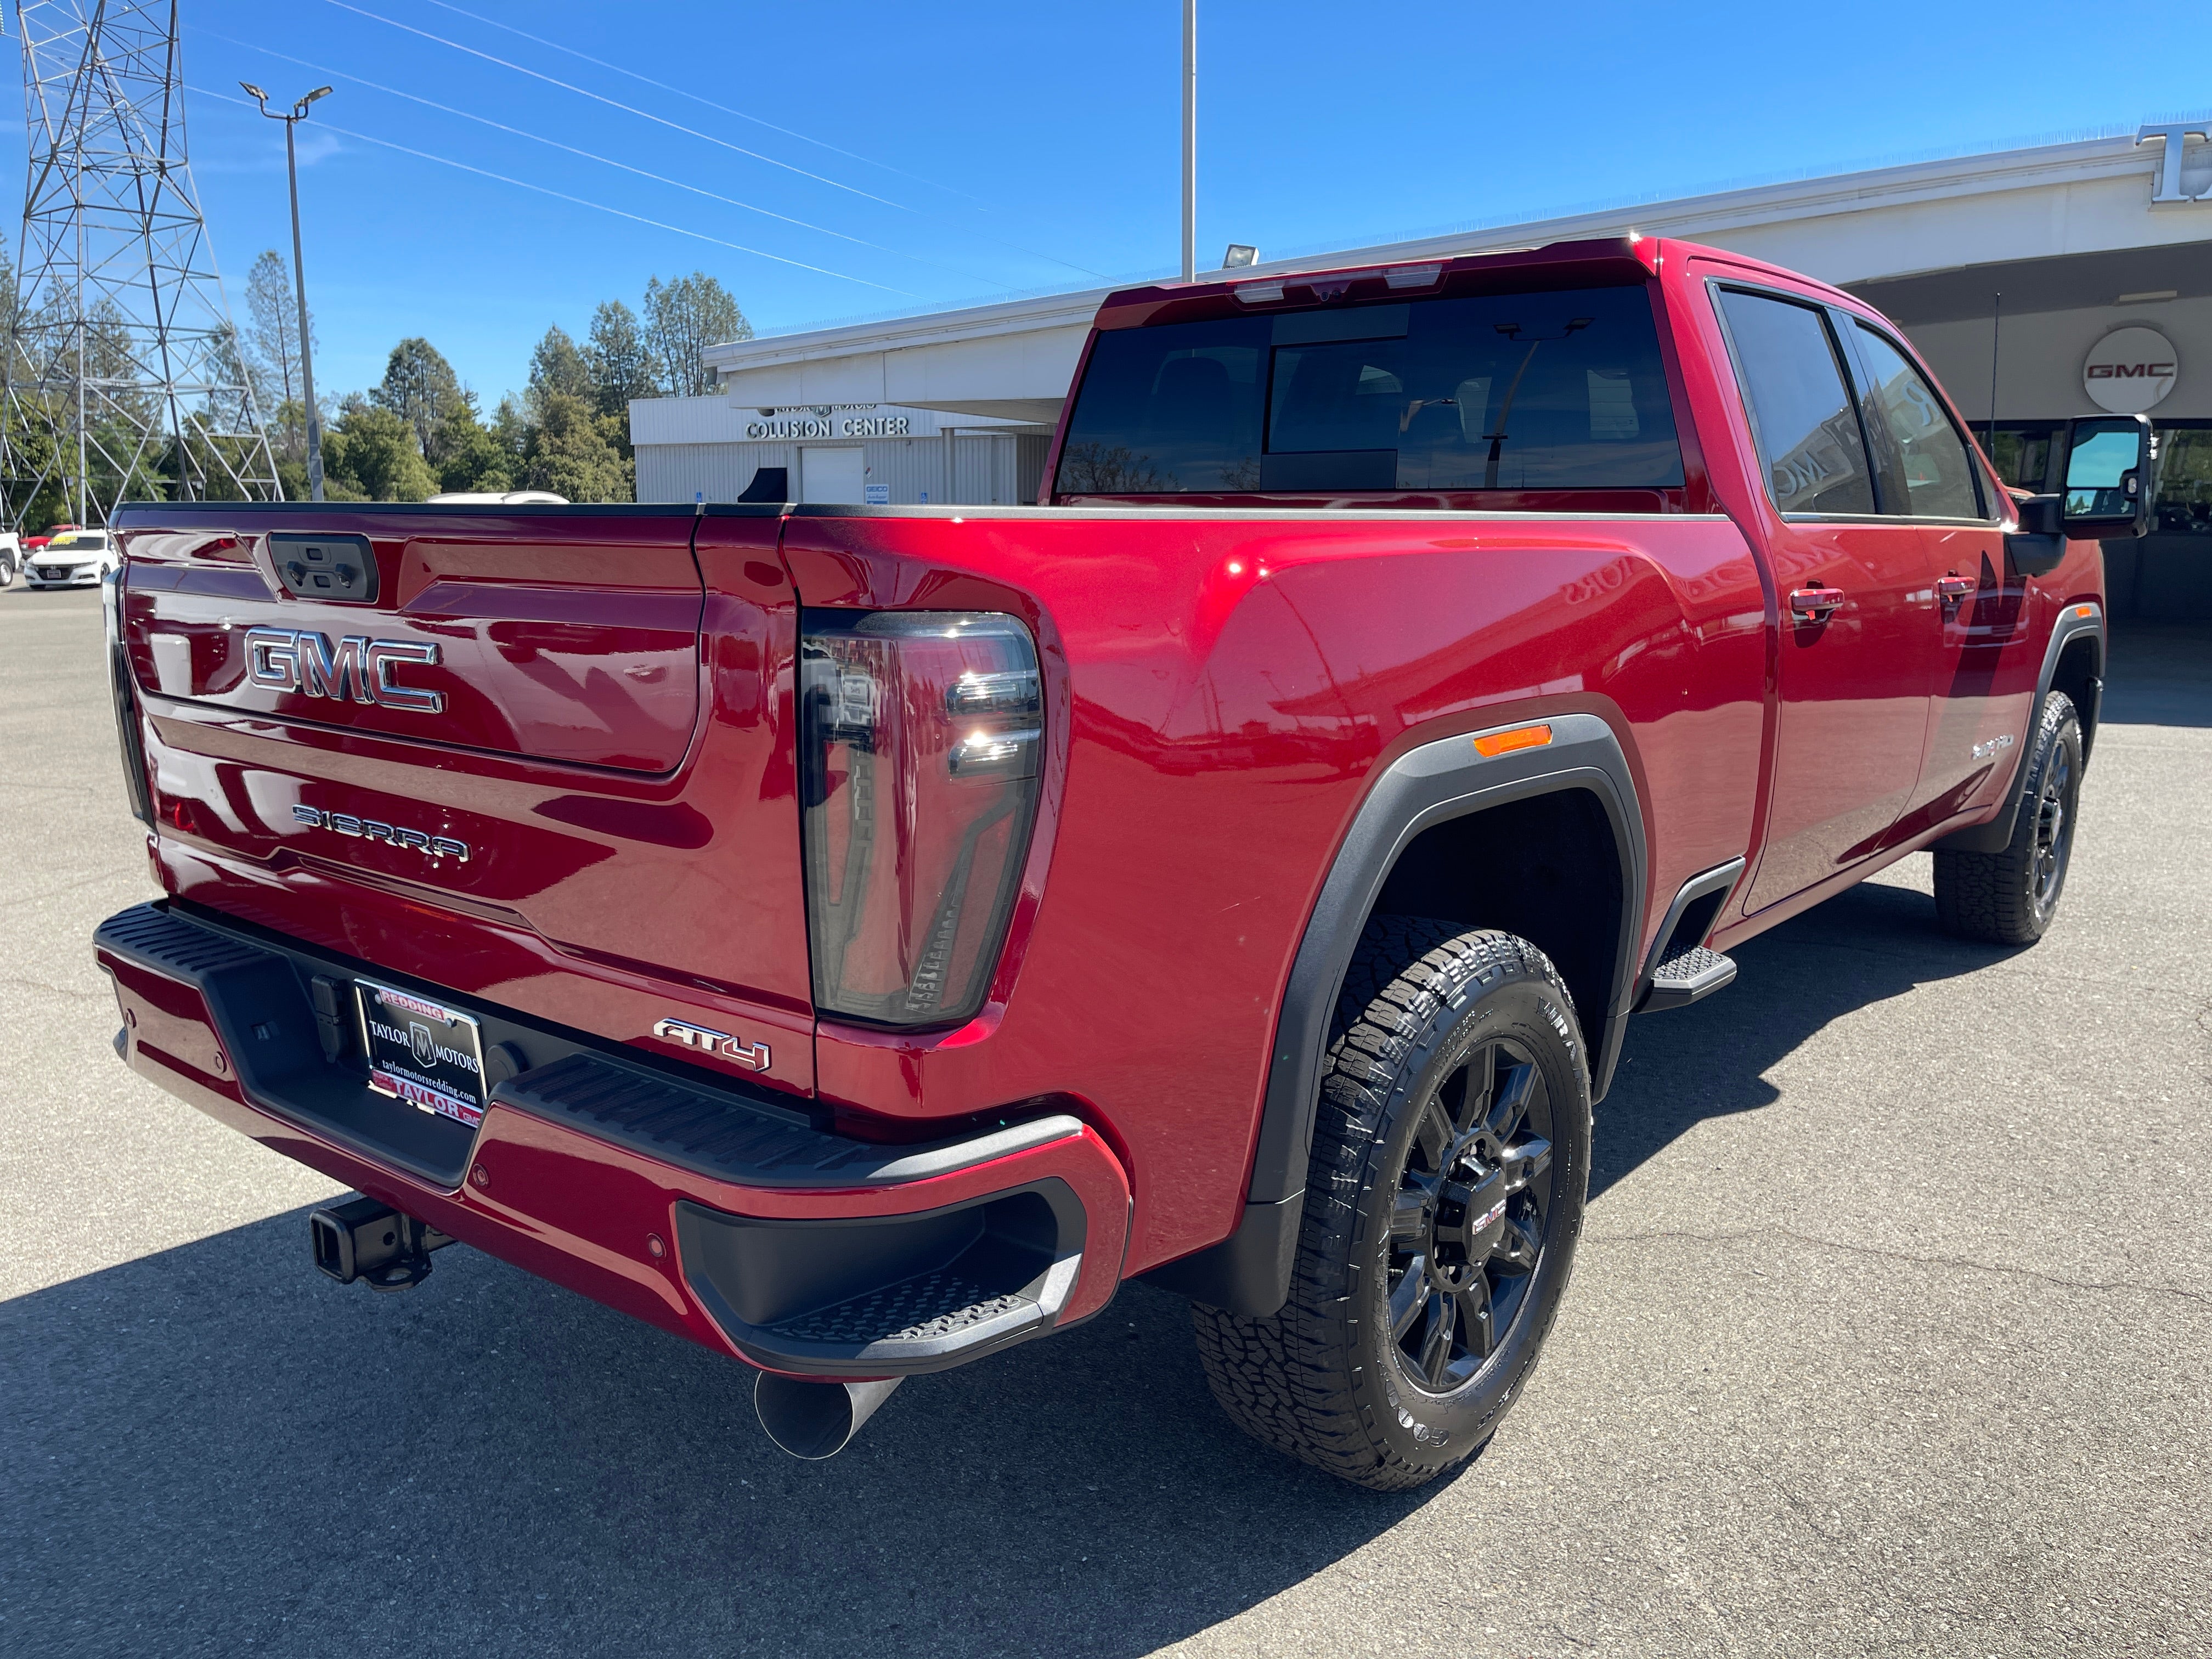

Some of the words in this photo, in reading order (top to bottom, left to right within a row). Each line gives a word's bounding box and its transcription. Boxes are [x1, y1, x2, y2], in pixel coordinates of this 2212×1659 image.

[2087, 363, 2174, 379] GMC
[746, 420, 832, 439] COLLISION
[842, 416, 910, 437] CENTER
[244, 627, 447, 714] GMC
[292, 804, 473, 862] SIERRA
[381, 989, 443, 1020] REDDING
[369, 1020, 411, 1048] TAYLOR
[435, 1043, 479, 1074] MOTORS
[653, 1017, 770, 1073] AT4
[382, 1059, 477, 1104] taylormotorsredding.com
[393, 1078, 460, 1117] TAYLOR
[1472, 1199, 1506, 1235] GMC
